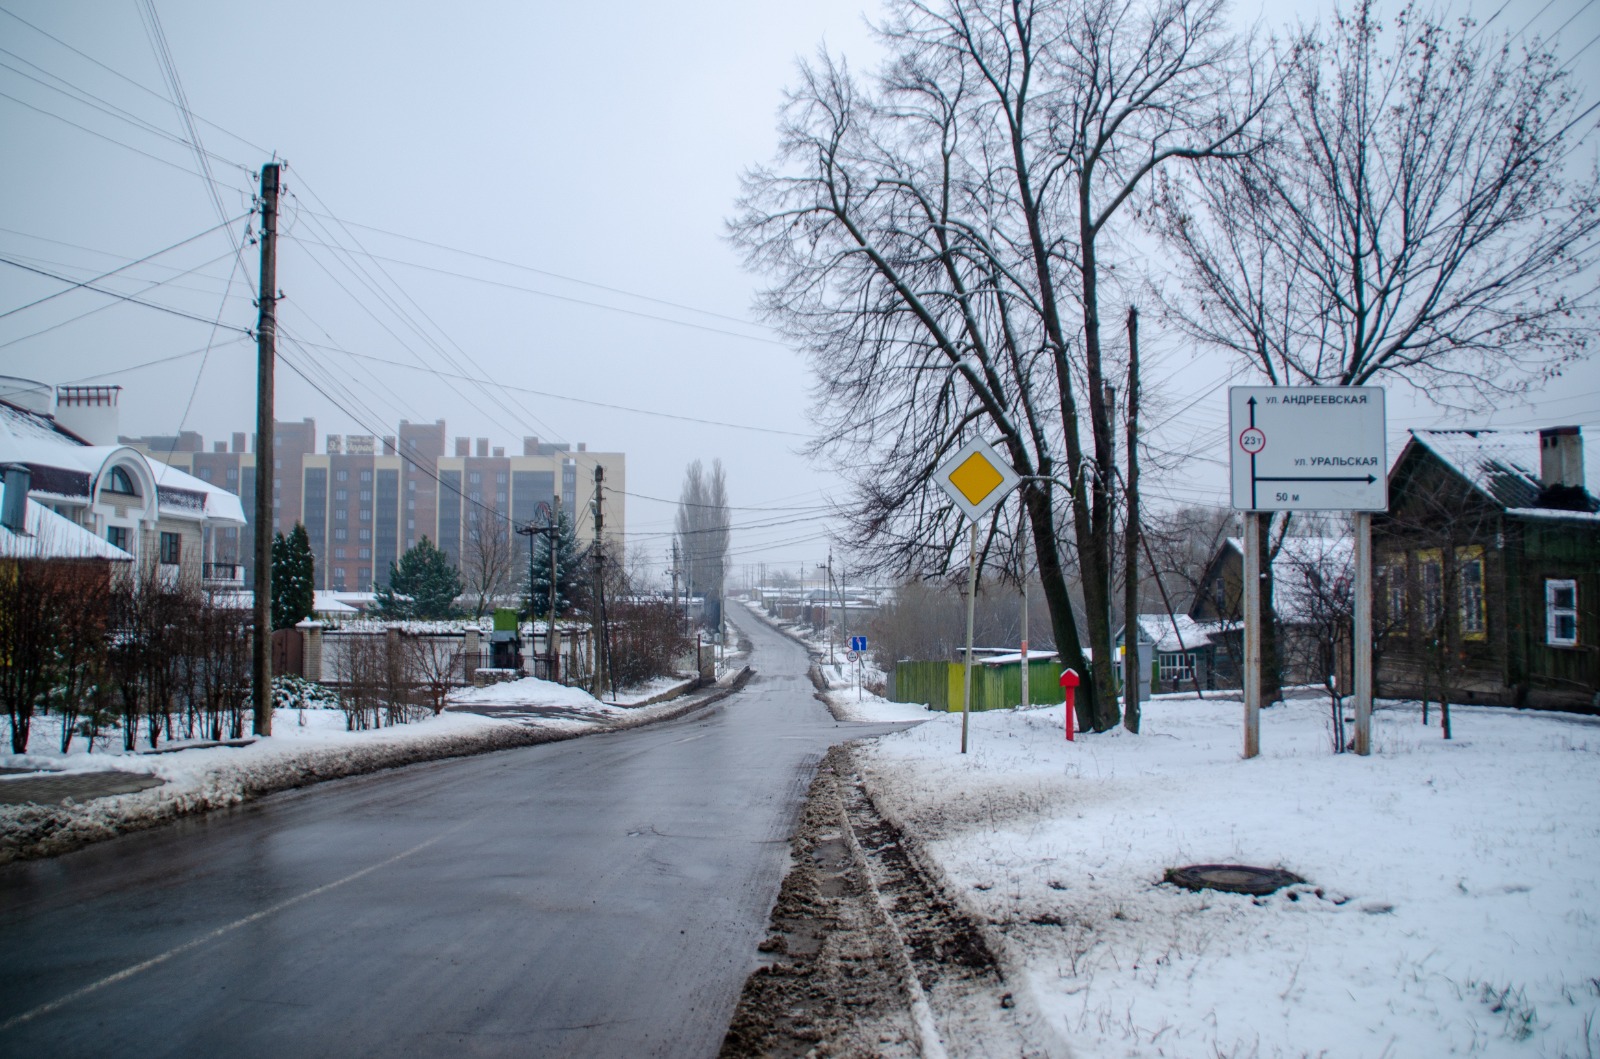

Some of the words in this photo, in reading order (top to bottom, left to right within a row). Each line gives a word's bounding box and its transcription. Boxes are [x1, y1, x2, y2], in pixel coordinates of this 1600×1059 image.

[1282, 395, 1367, 405] АНДРЕЕВСКАЯ
[1310, 457, 1378, 466] УРАЛЬСКАЯ
[1276, 492, 1288, 502] 50
